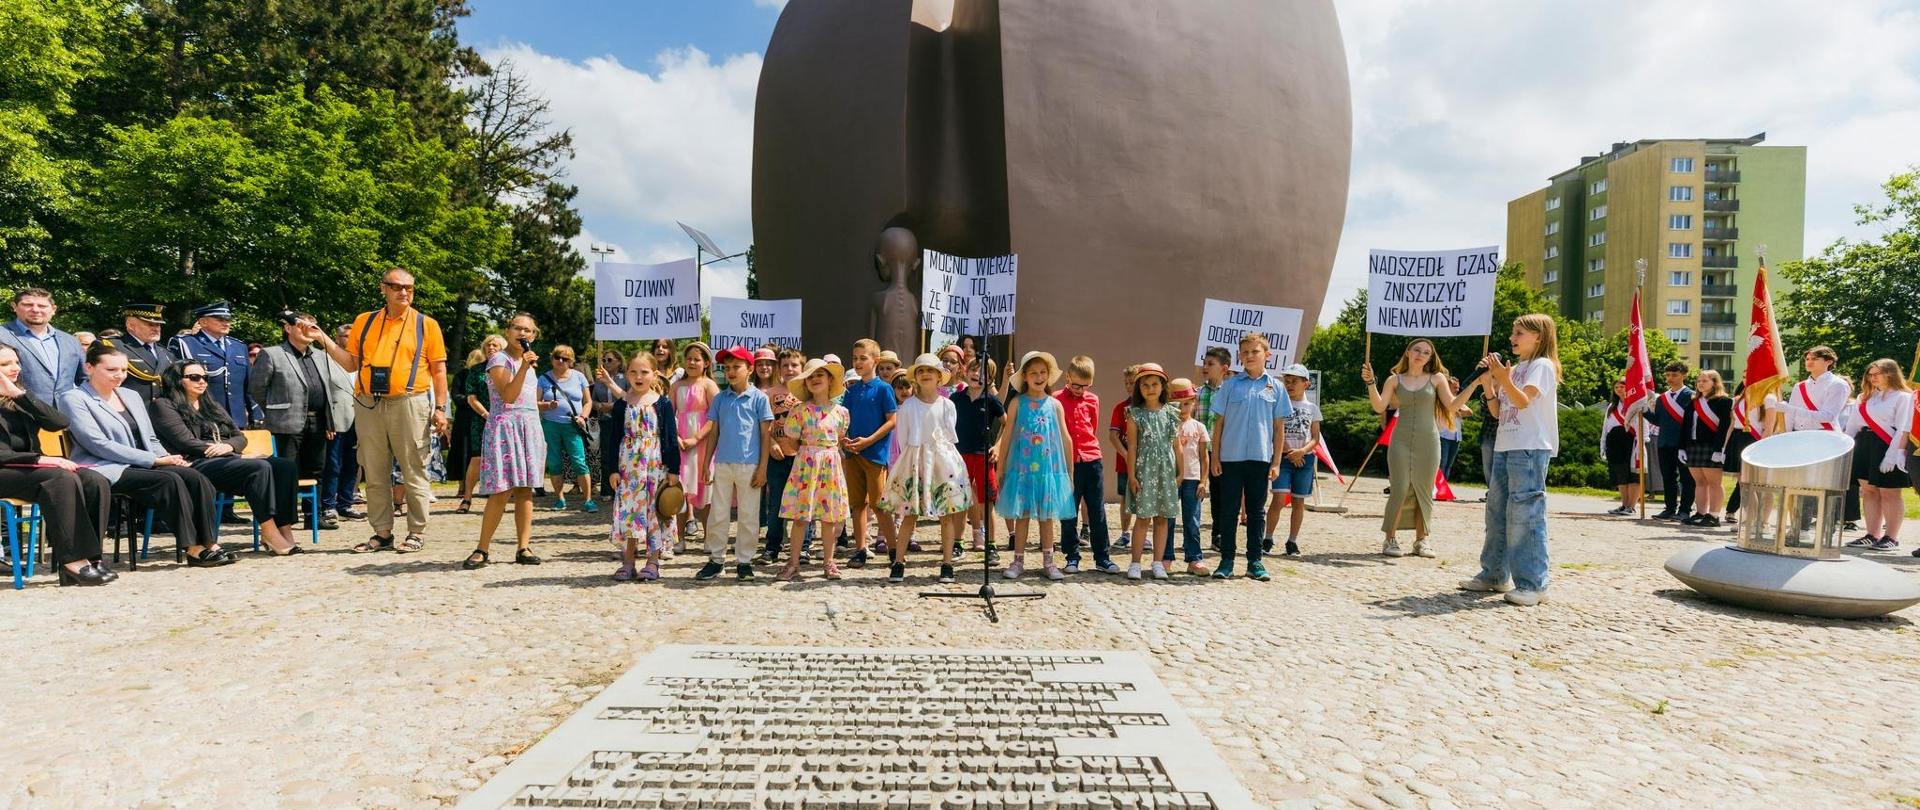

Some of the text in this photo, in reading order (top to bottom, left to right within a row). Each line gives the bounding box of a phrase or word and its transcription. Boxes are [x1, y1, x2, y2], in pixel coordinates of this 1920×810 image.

[929, 251, 1015, 276] MOCNO WIERZĘ
[1369, 252, 1499, 277] NADSZEDŁ CZAS
[625, 278, 675, 298] DZIWNY
[943, 274, 953, 293] W
[1384, 279, 1467, 303] ZNISZCZYĆ
[929, 289, 1015, 315] ŻE TEN ŚWIAT
[596, 303, 701, 326] JEST TEN ŚWIAT
[741, 310, 776, 329] ŚWIAT
[921, 310, 936, 332] NIE
[1229, 308, 1264, 328] LUDZI
[1378, 305, 1462, 329] NIENAWIŚĆ
[710, 334, 762, 352] LUDZKICH
[1207, 325, 1253, 345] DOBRE
[647, 723, 699, 734] DO
[636, 753, 758, 766] CZASIE
[1053, 773, 1171, 788] PRZEZ
